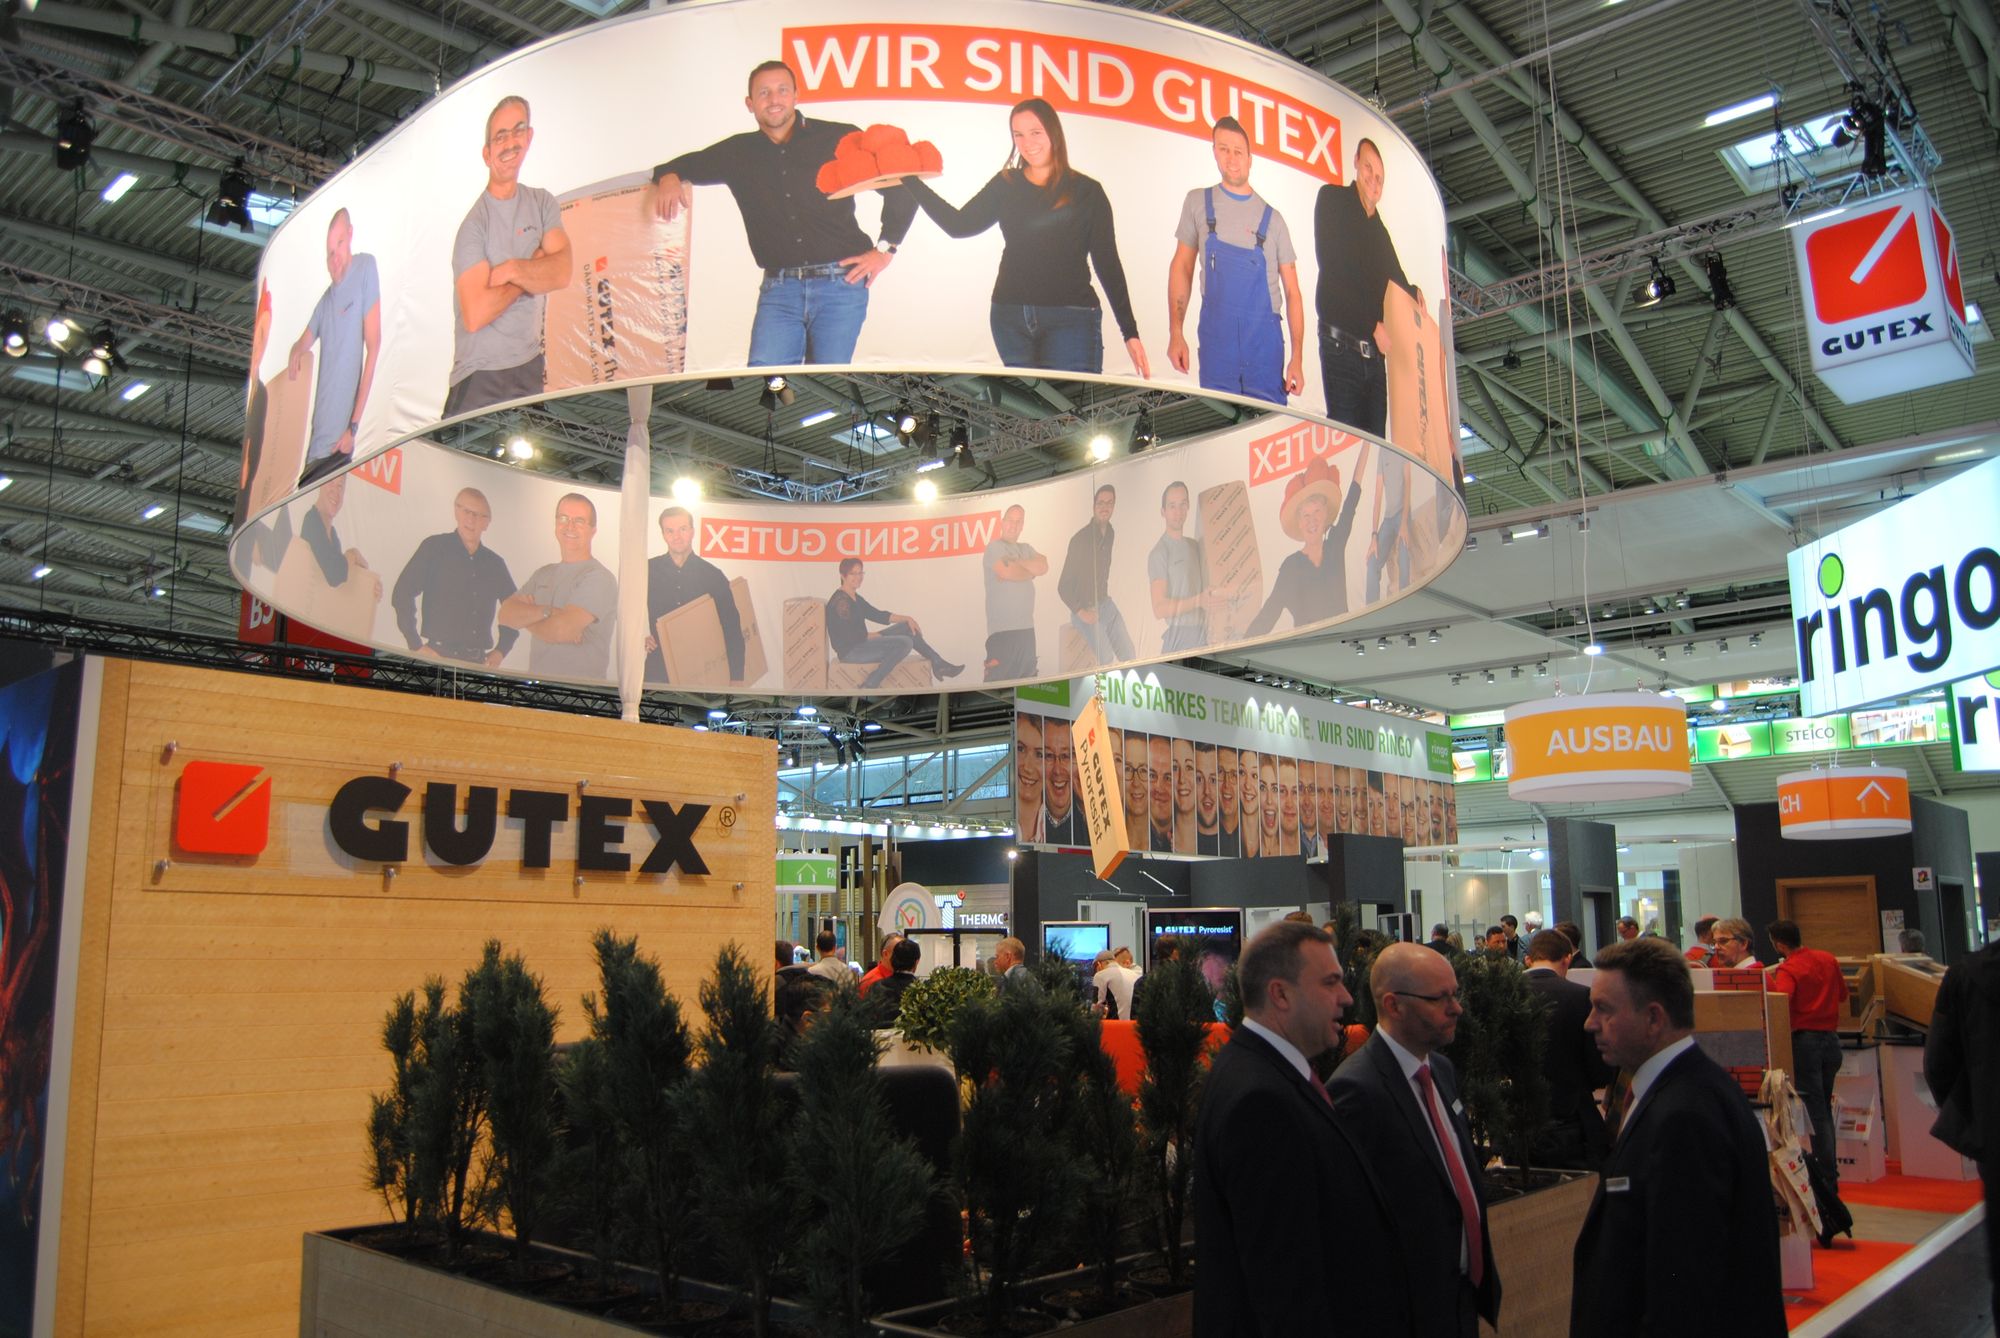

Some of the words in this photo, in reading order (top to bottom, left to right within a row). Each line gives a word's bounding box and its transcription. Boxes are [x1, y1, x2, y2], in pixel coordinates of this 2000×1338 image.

[792, 35, 945, 91] WIR
[963, 38, 1135, 108] SIND
[1152, 68, 1338, 176] GUTEX
[1821, 312, 1934, 356] GUTEX
[1796, 547, 2000, 684] ringo
[1099, 674, 1126, 705] EIN
[1131, 682, 1207, 721] STARKES
[1211, 697, 1254, 730] TEAM
[1317, 719, 1343, 747] WIR
[1346, 726, 1375, 751] SIND
[1378, 731, 1413, 758] RINGO
[1546, 724, 1673, 757] AUSBAU
[1785, 725, 1836, 742] STEICO
[1092, 751, 1111, 833] GUTEX
[1165, 925, 1196, 934] GUTEX
